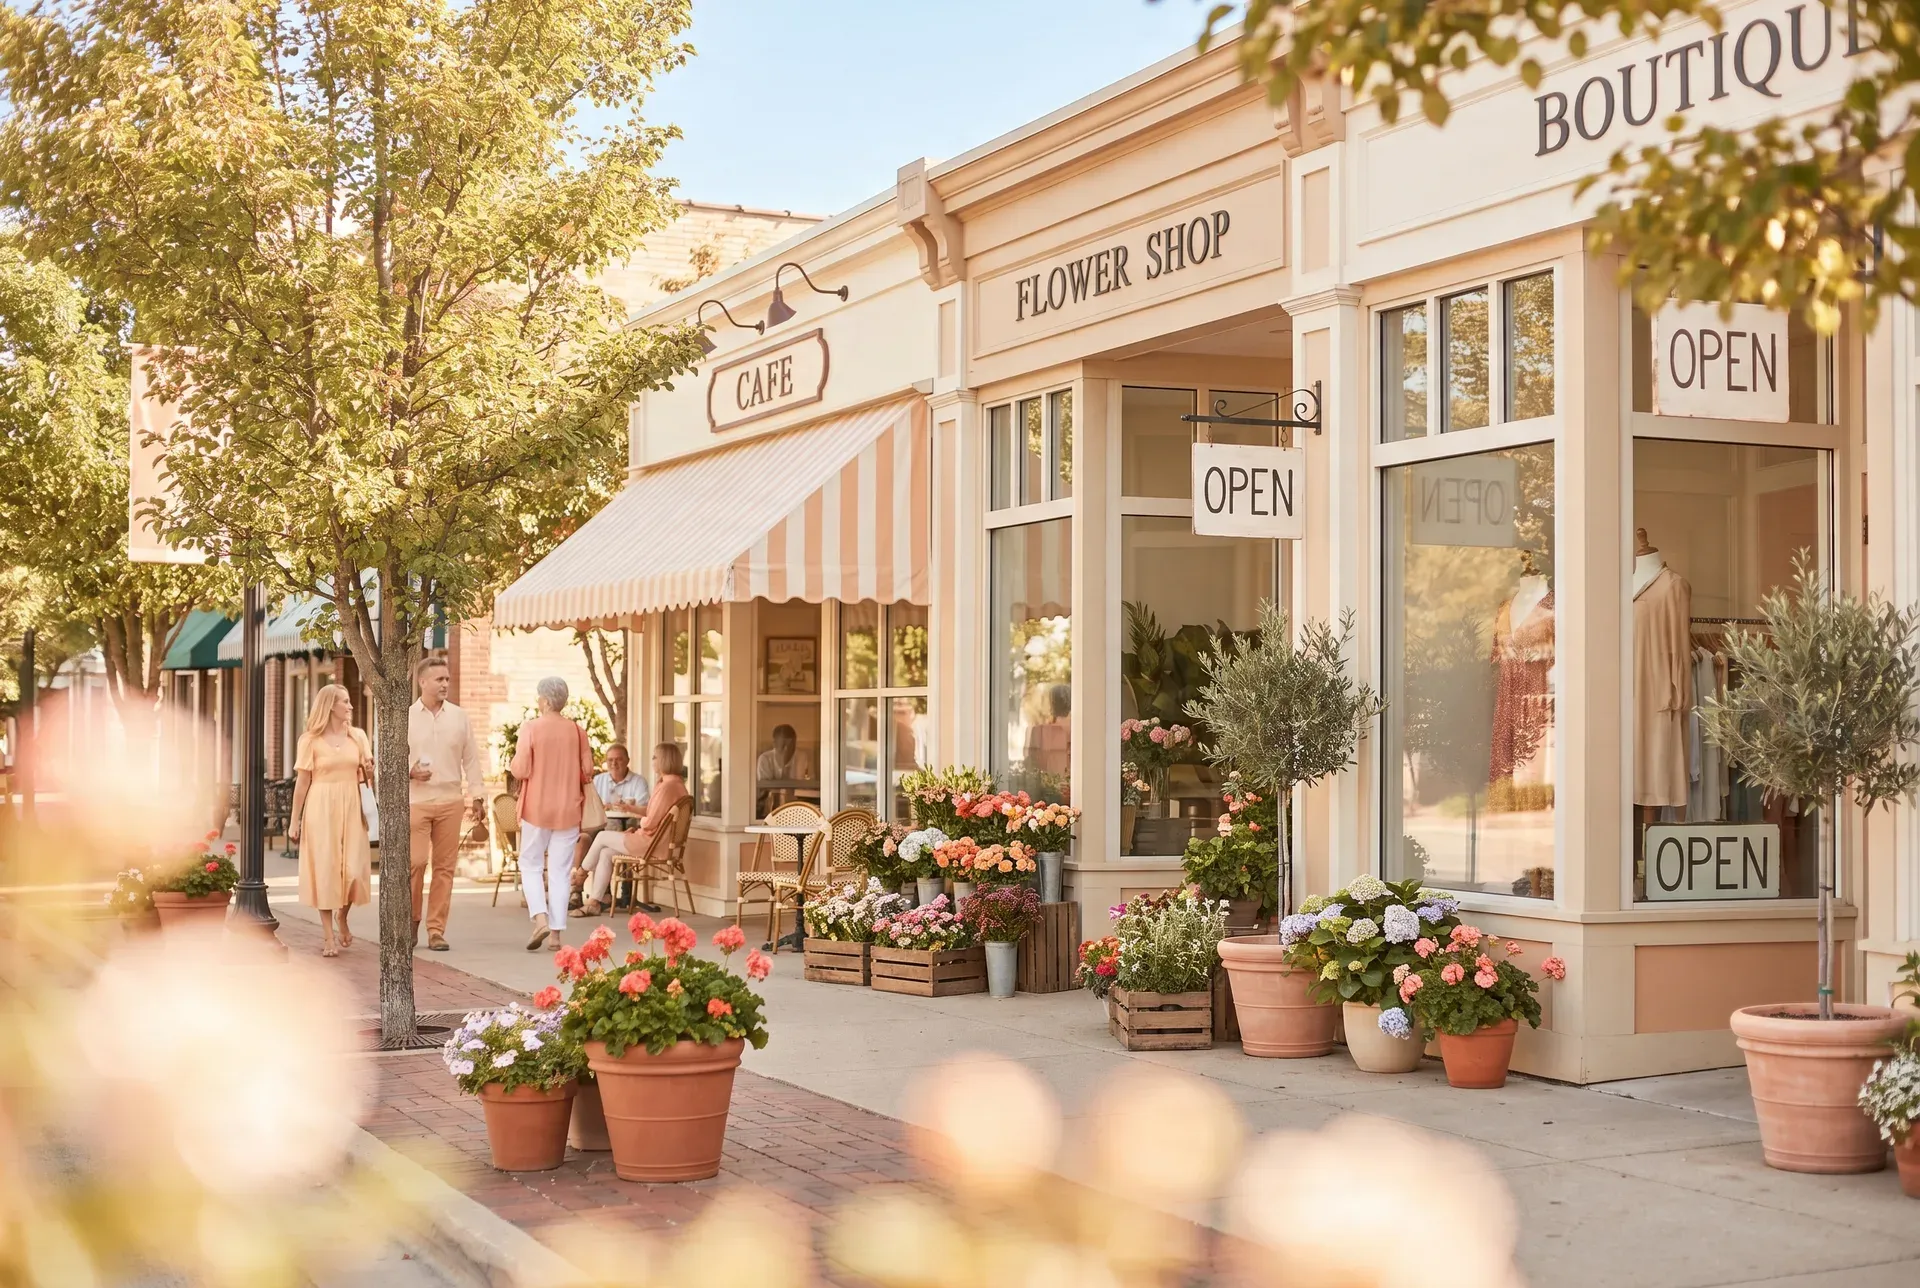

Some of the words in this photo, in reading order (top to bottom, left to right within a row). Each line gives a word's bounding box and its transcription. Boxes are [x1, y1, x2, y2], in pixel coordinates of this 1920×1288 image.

[1015, 245, 1132, 321] FLOWER
[1146, 209, 1231, 280] SHOP
[736, 355, 793, 411] CAFE
[1670, 328, 1777, 392] OPEN
[1204, 466, 1293, 517] OPEN
[1656, 836, 1768, 892] OPEN
